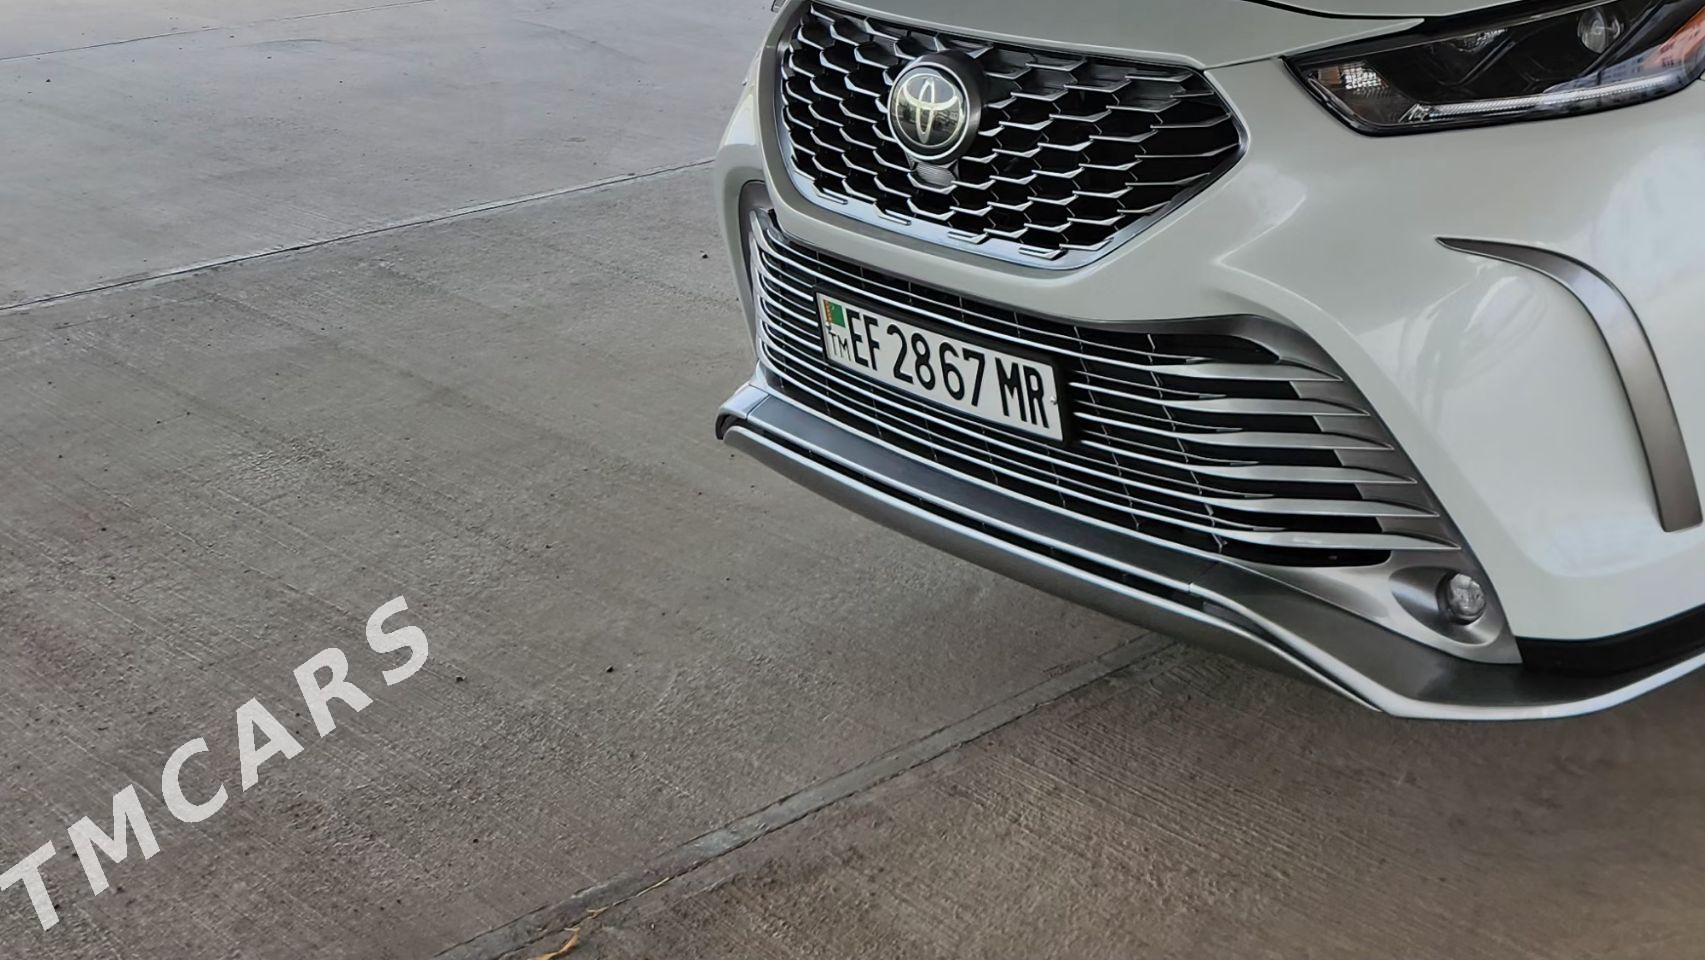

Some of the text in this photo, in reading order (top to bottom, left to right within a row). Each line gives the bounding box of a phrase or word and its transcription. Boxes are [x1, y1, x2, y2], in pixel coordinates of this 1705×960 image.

[828, 330, 851, 361] TM
[846, 308, 1049, 428] EF 2867 MR
